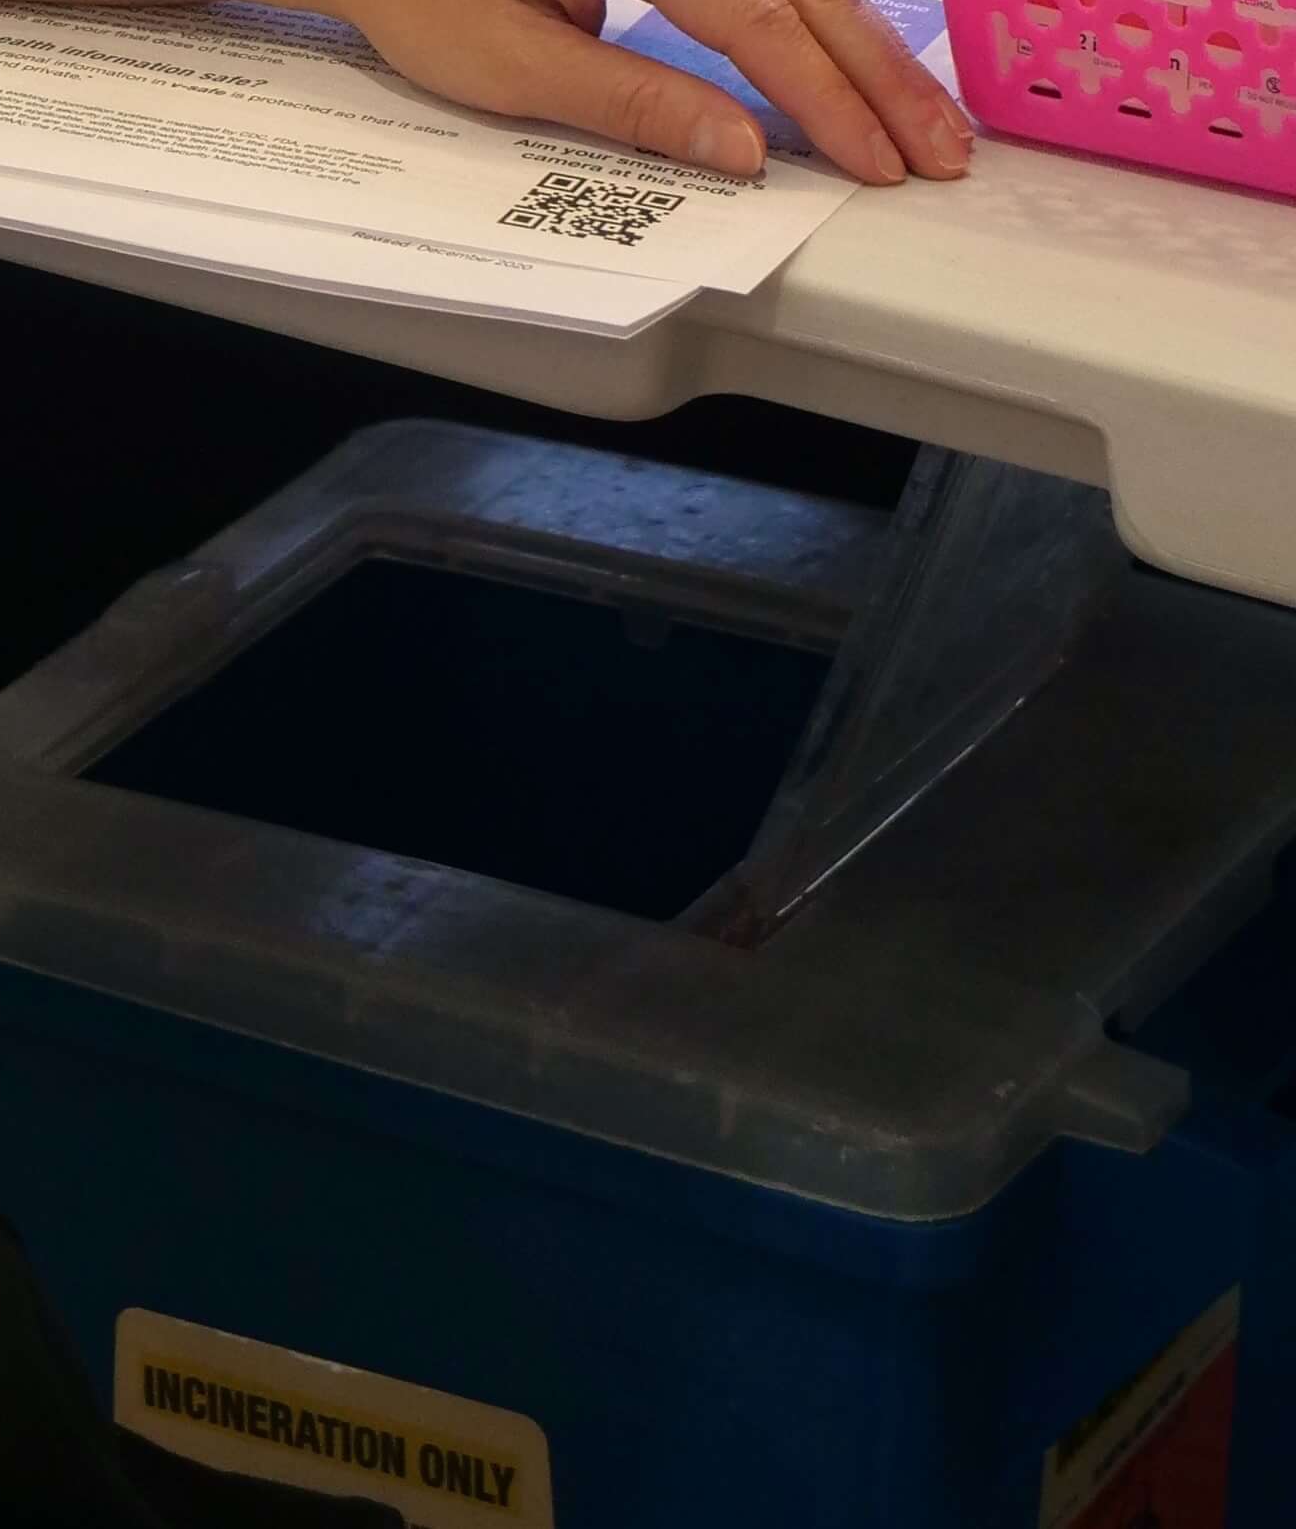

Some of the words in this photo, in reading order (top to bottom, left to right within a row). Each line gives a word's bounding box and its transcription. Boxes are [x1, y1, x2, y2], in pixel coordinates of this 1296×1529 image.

[31, 16, 71, 28] after
[72, 23, 113, 36] your
[113, 28, 151, 42] final
[151, 37, 194, 50] dose
[197, 44, 219, 53] of
[219, 48, 286, 66] vaccine.
[179, 29, 226, 45] You'll
[225, 40, 261, 53] also
[265, 46, 325, 62] receive
[58, 45, 196, 77] information
[198, 72, 269, 89] safe?
[53, 59, 148, 84] information
[151, 77, 168, 87] in
[171, 81, 228, 97] v-safe
[230, 91, 246, 100] is
[247, 94, 333, 115] protected
[334, 110, 357, 120] so
[360, 113, 395, 128] that
[397, 121, 412, 130] it
[412, 125, 460, 139] stays
[513, 138, 558, 152] Aim
[560, 145, 614, 161] your
[615, 155, 767, 191] smartphone's
[520, 151, 603, 174] camera
[608, 166, 633, 177] at
[637, 170, 677, 188] this
[681, 178, 738, 198] code
[351, 230, 411, 249] Revised
[416, 243, 494, 264] December
[493, 257, 535, 271] 2020
[142, 1364, 406, 1479] INCINERATION
[418, 1443, 517, 1509] ONLY
